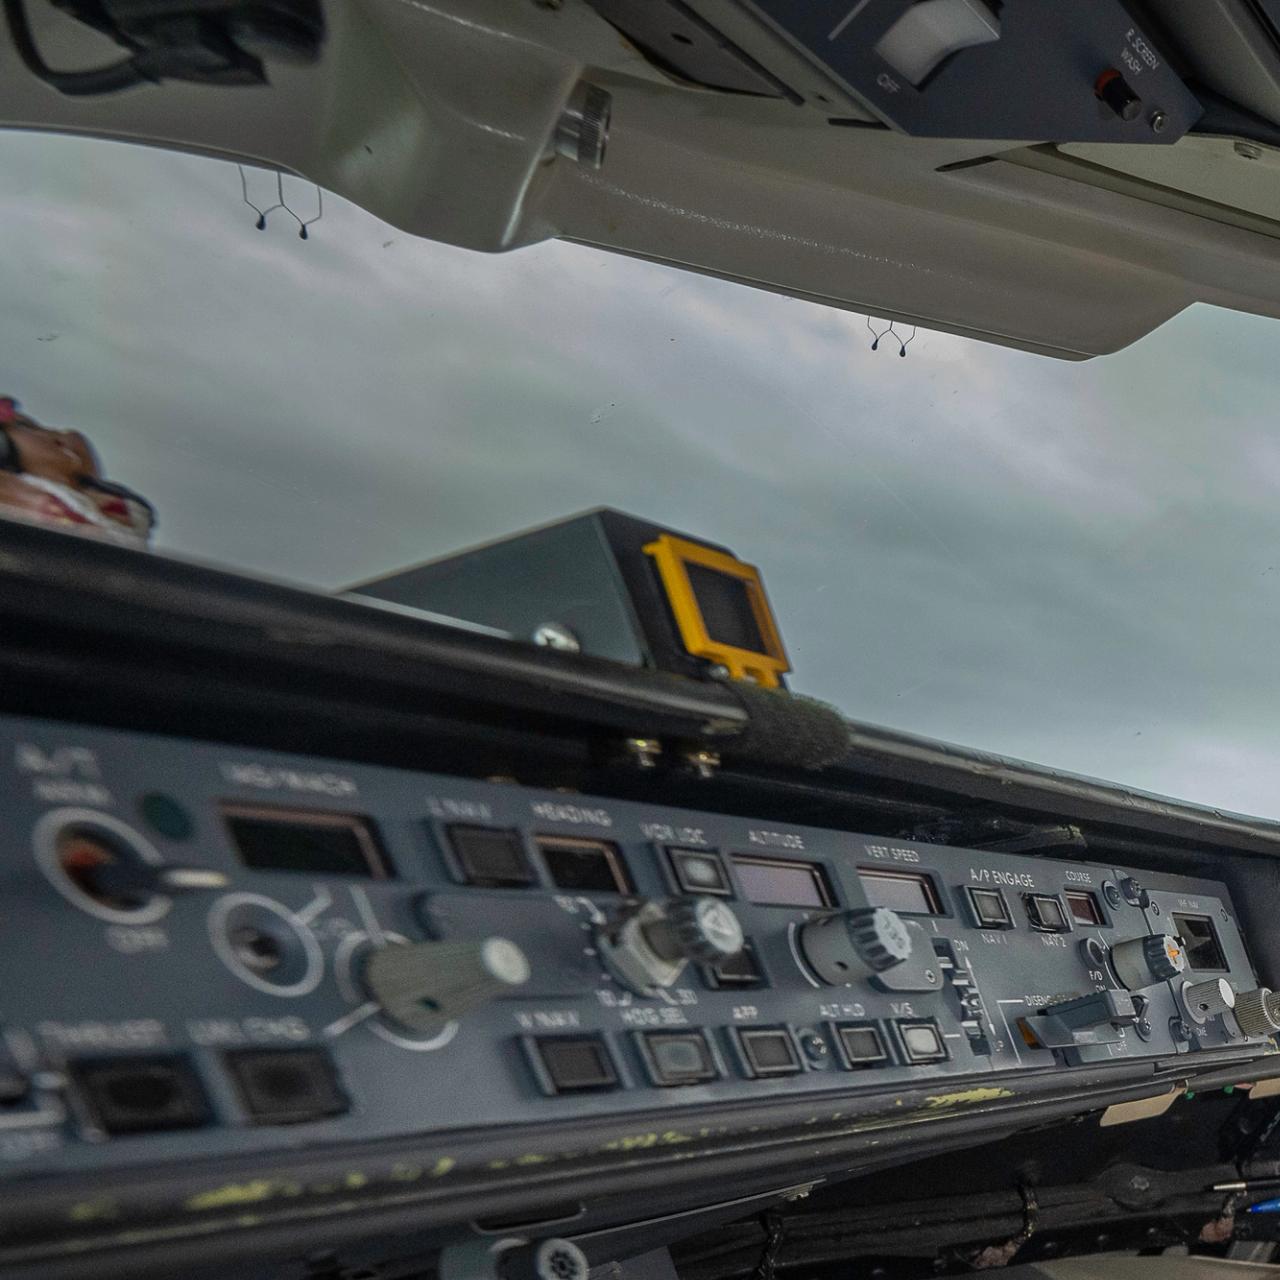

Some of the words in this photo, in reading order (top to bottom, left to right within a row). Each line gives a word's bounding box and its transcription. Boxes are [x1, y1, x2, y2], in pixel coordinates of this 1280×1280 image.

[970, 868, 991, 883] A/P
[993, 868, 1035, 889] ENGAGE
[1065, 870, 1092, 884] COURSE
[1088, 970, 1103, 982] F/D
